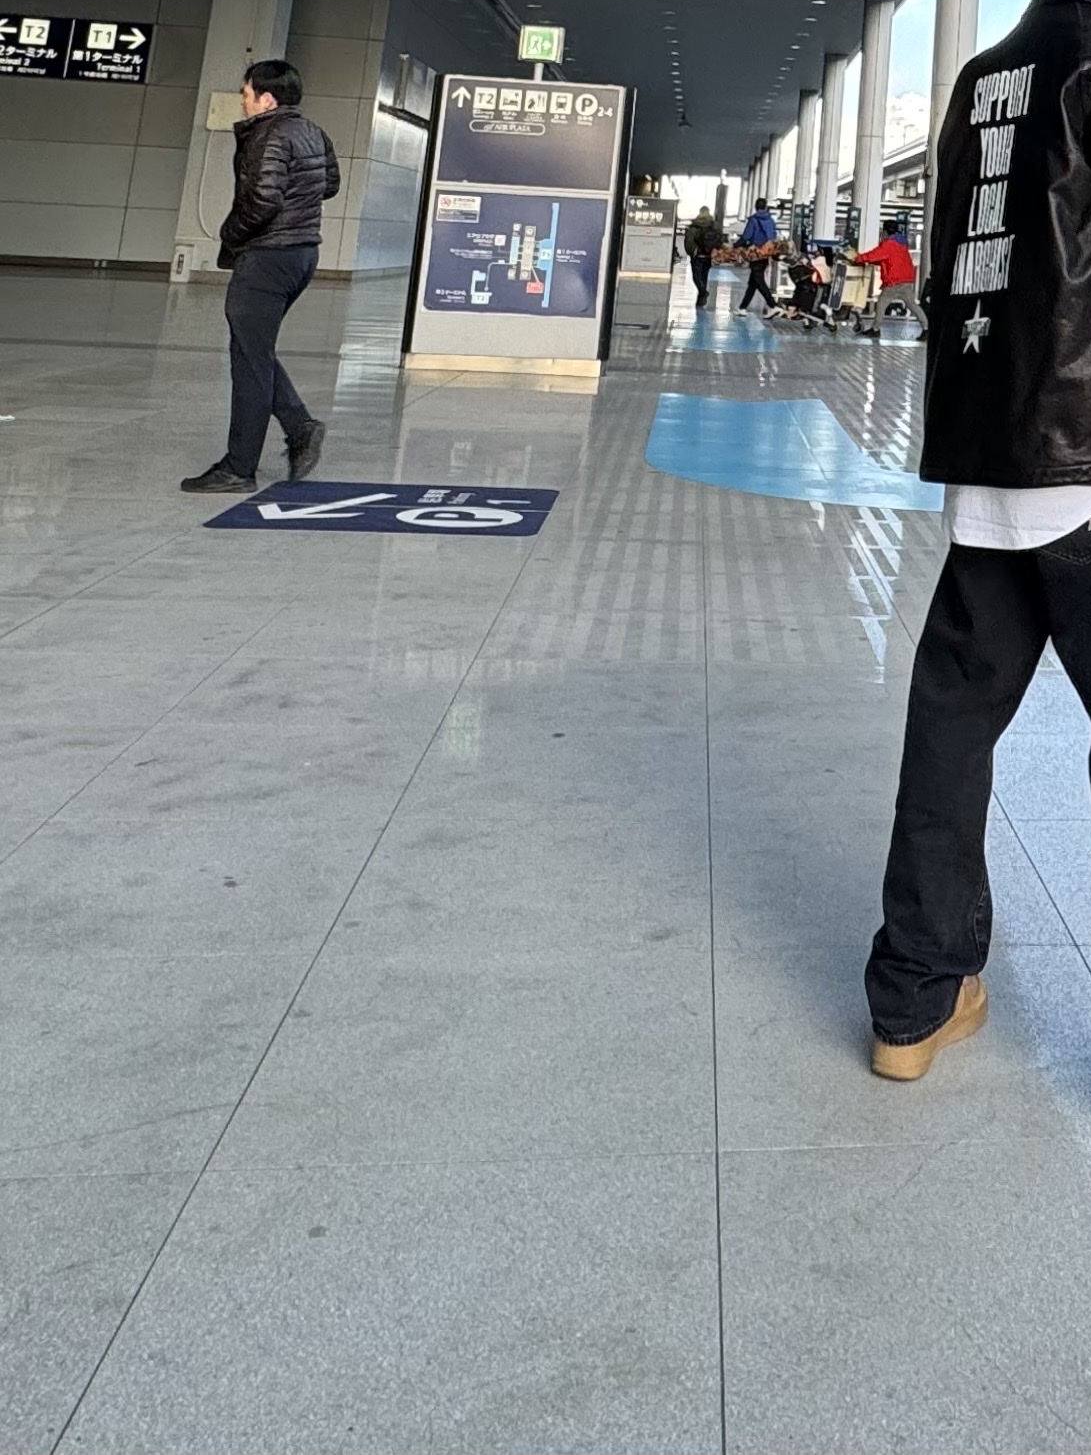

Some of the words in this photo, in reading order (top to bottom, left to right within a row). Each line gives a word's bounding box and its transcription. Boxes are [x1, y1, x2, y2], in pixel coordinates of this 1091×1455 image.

[24, 25, 46, 39] T2
[93, 30, 112, 43] T1
[23, 58, 30, 66] 2
[97, 62, 133, 73] Terminal
[477, 92, 494, 105] T2
[970, 64, 1035, 125] SUPPORT
[581, 97, 593, 112] P
[597, 106, 614, 117] 2-4
[980, 124, 1015, 179] YOUR
[967, 180, 1009, 237] LOCAL
